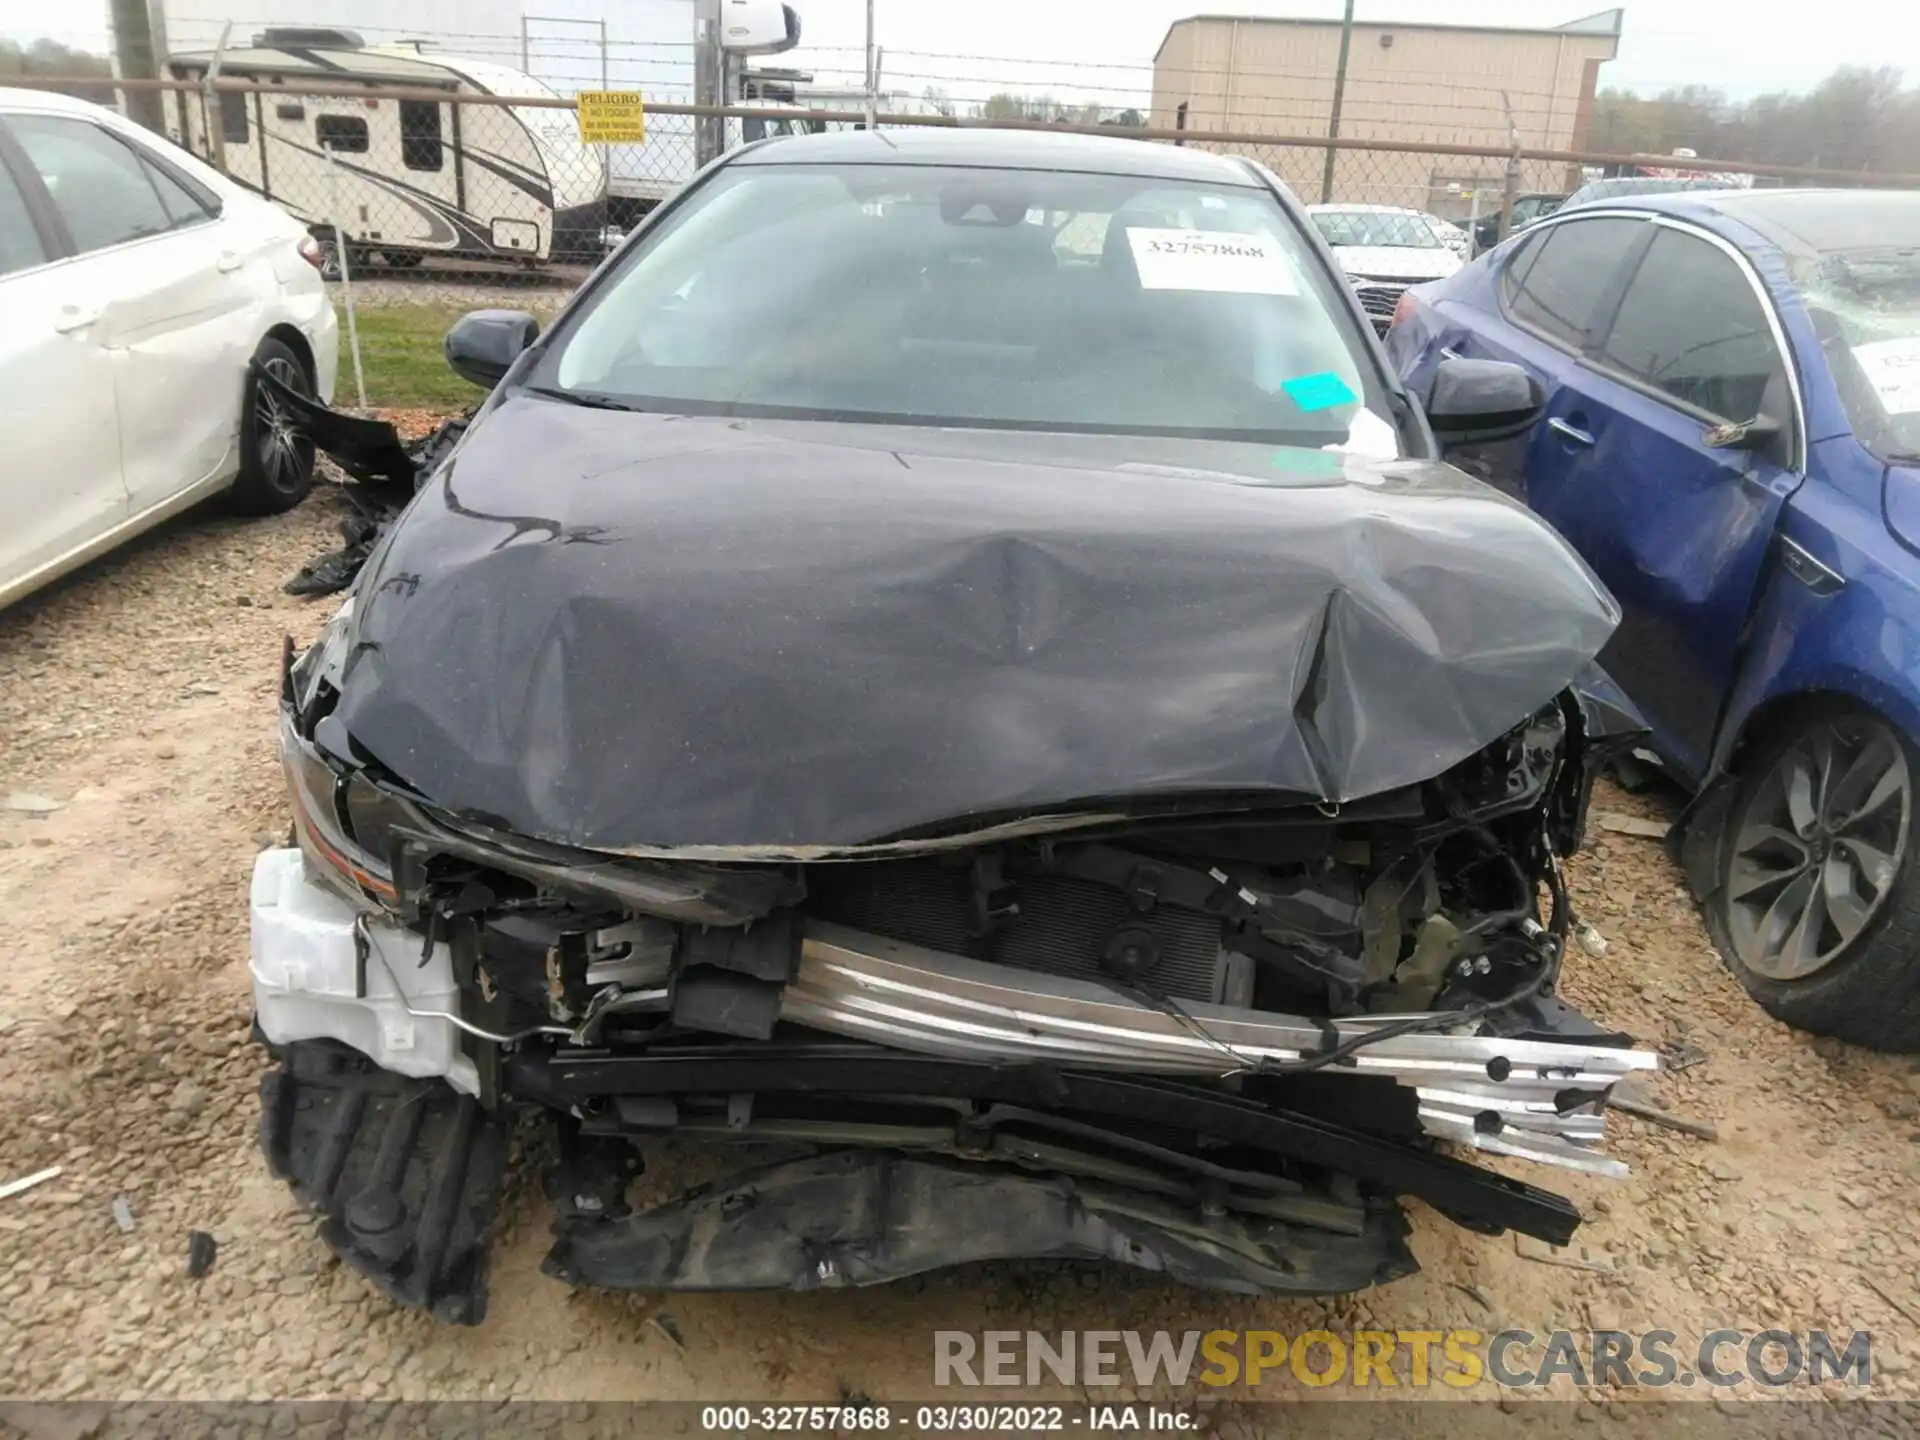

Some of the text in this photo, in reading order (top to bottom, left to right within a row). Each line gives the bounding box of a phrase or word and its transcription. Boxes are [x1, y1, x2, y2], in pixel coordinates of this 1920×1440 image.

[581, 93, 640, 104] PELIGRO
[590, 107, 632, 117] NO TOQUE
[605, 131, 642, 142] VOLTIOS
[1147, 239, 1266, 259] 32757868
